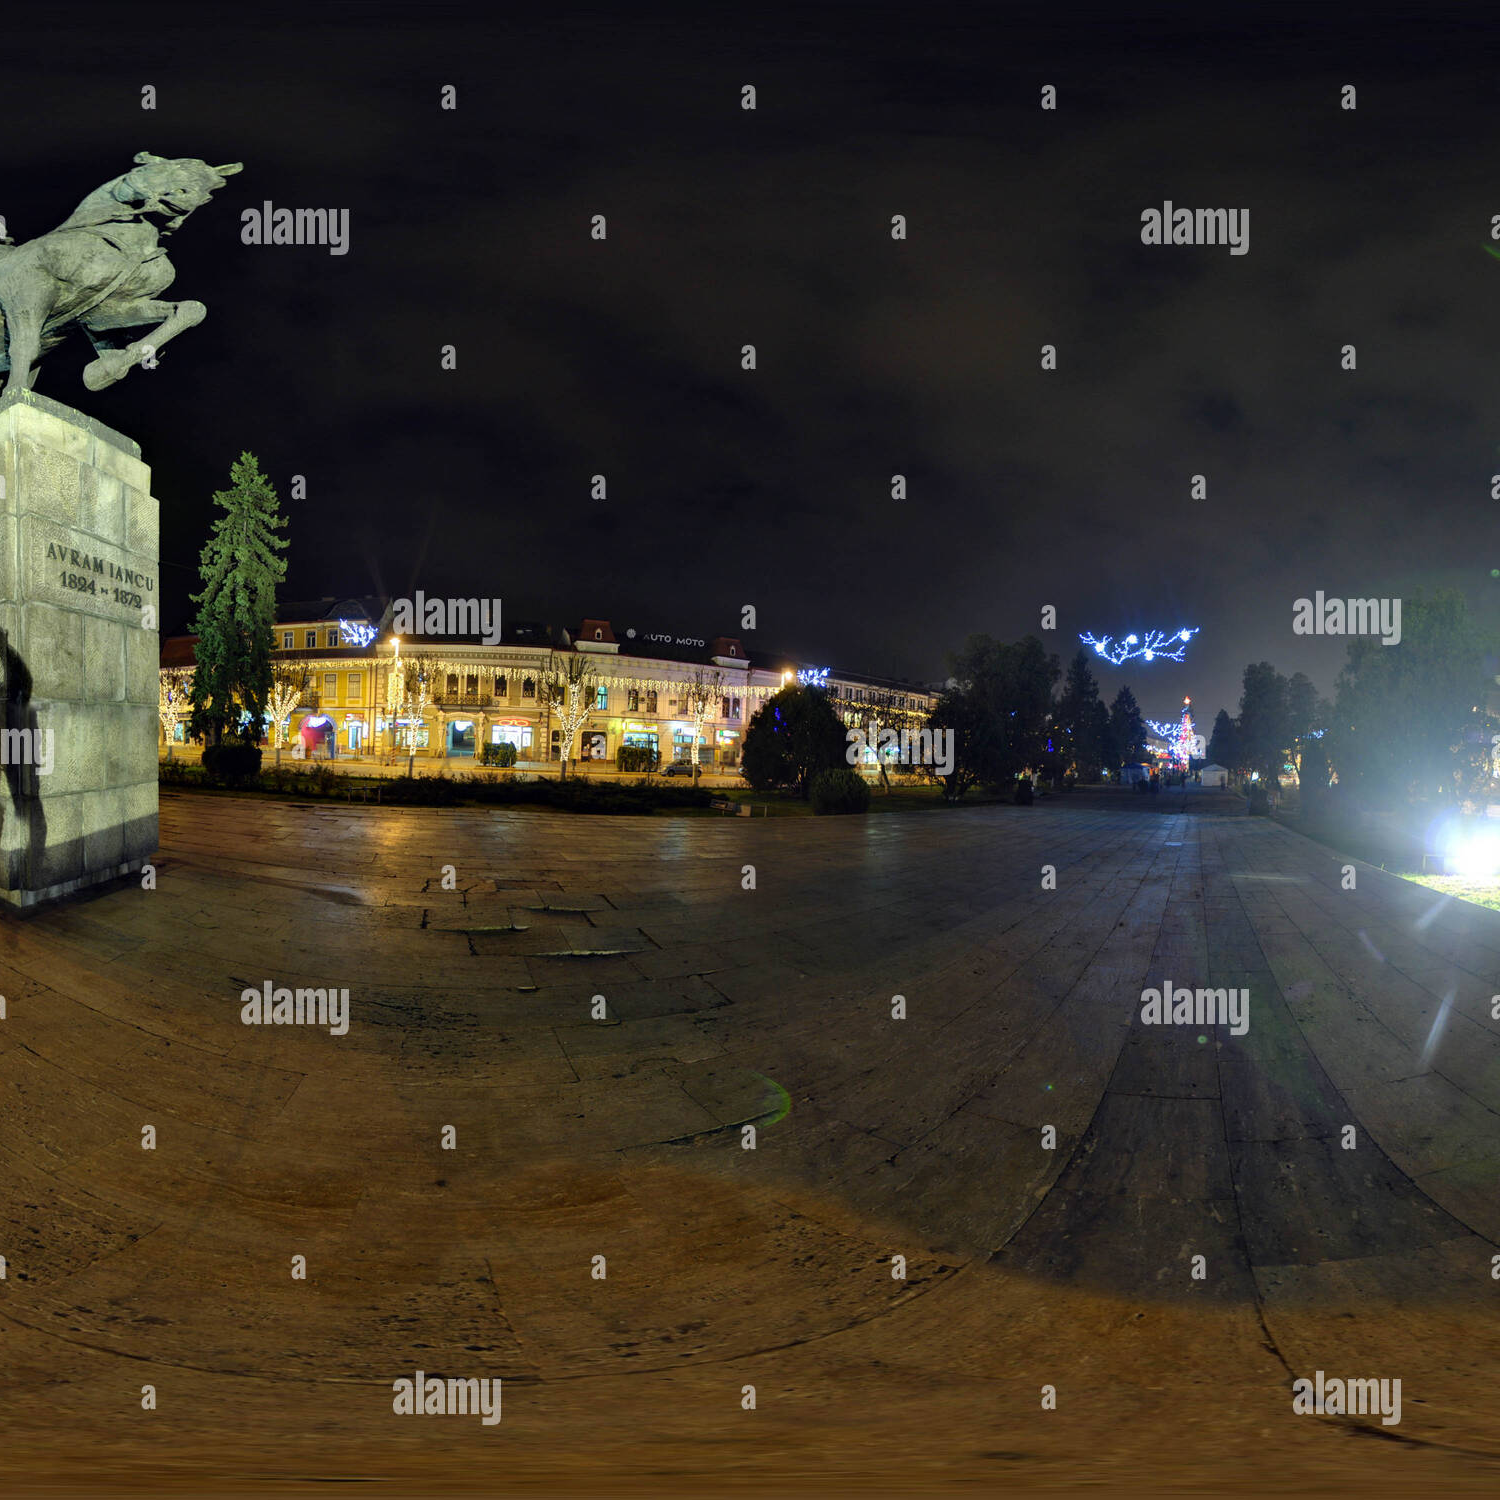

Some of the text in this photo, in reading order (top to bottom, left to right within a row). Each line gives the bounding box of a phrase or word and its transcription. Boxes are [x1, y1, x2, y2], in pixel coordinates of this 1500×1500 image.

[46, 542, 154, 592] AVRAM IANCU
[59, 570, 96, 596] 1824
[113, 586, 142, 609] 1872
[643, 634, 705, 647] AUTO MOTO
